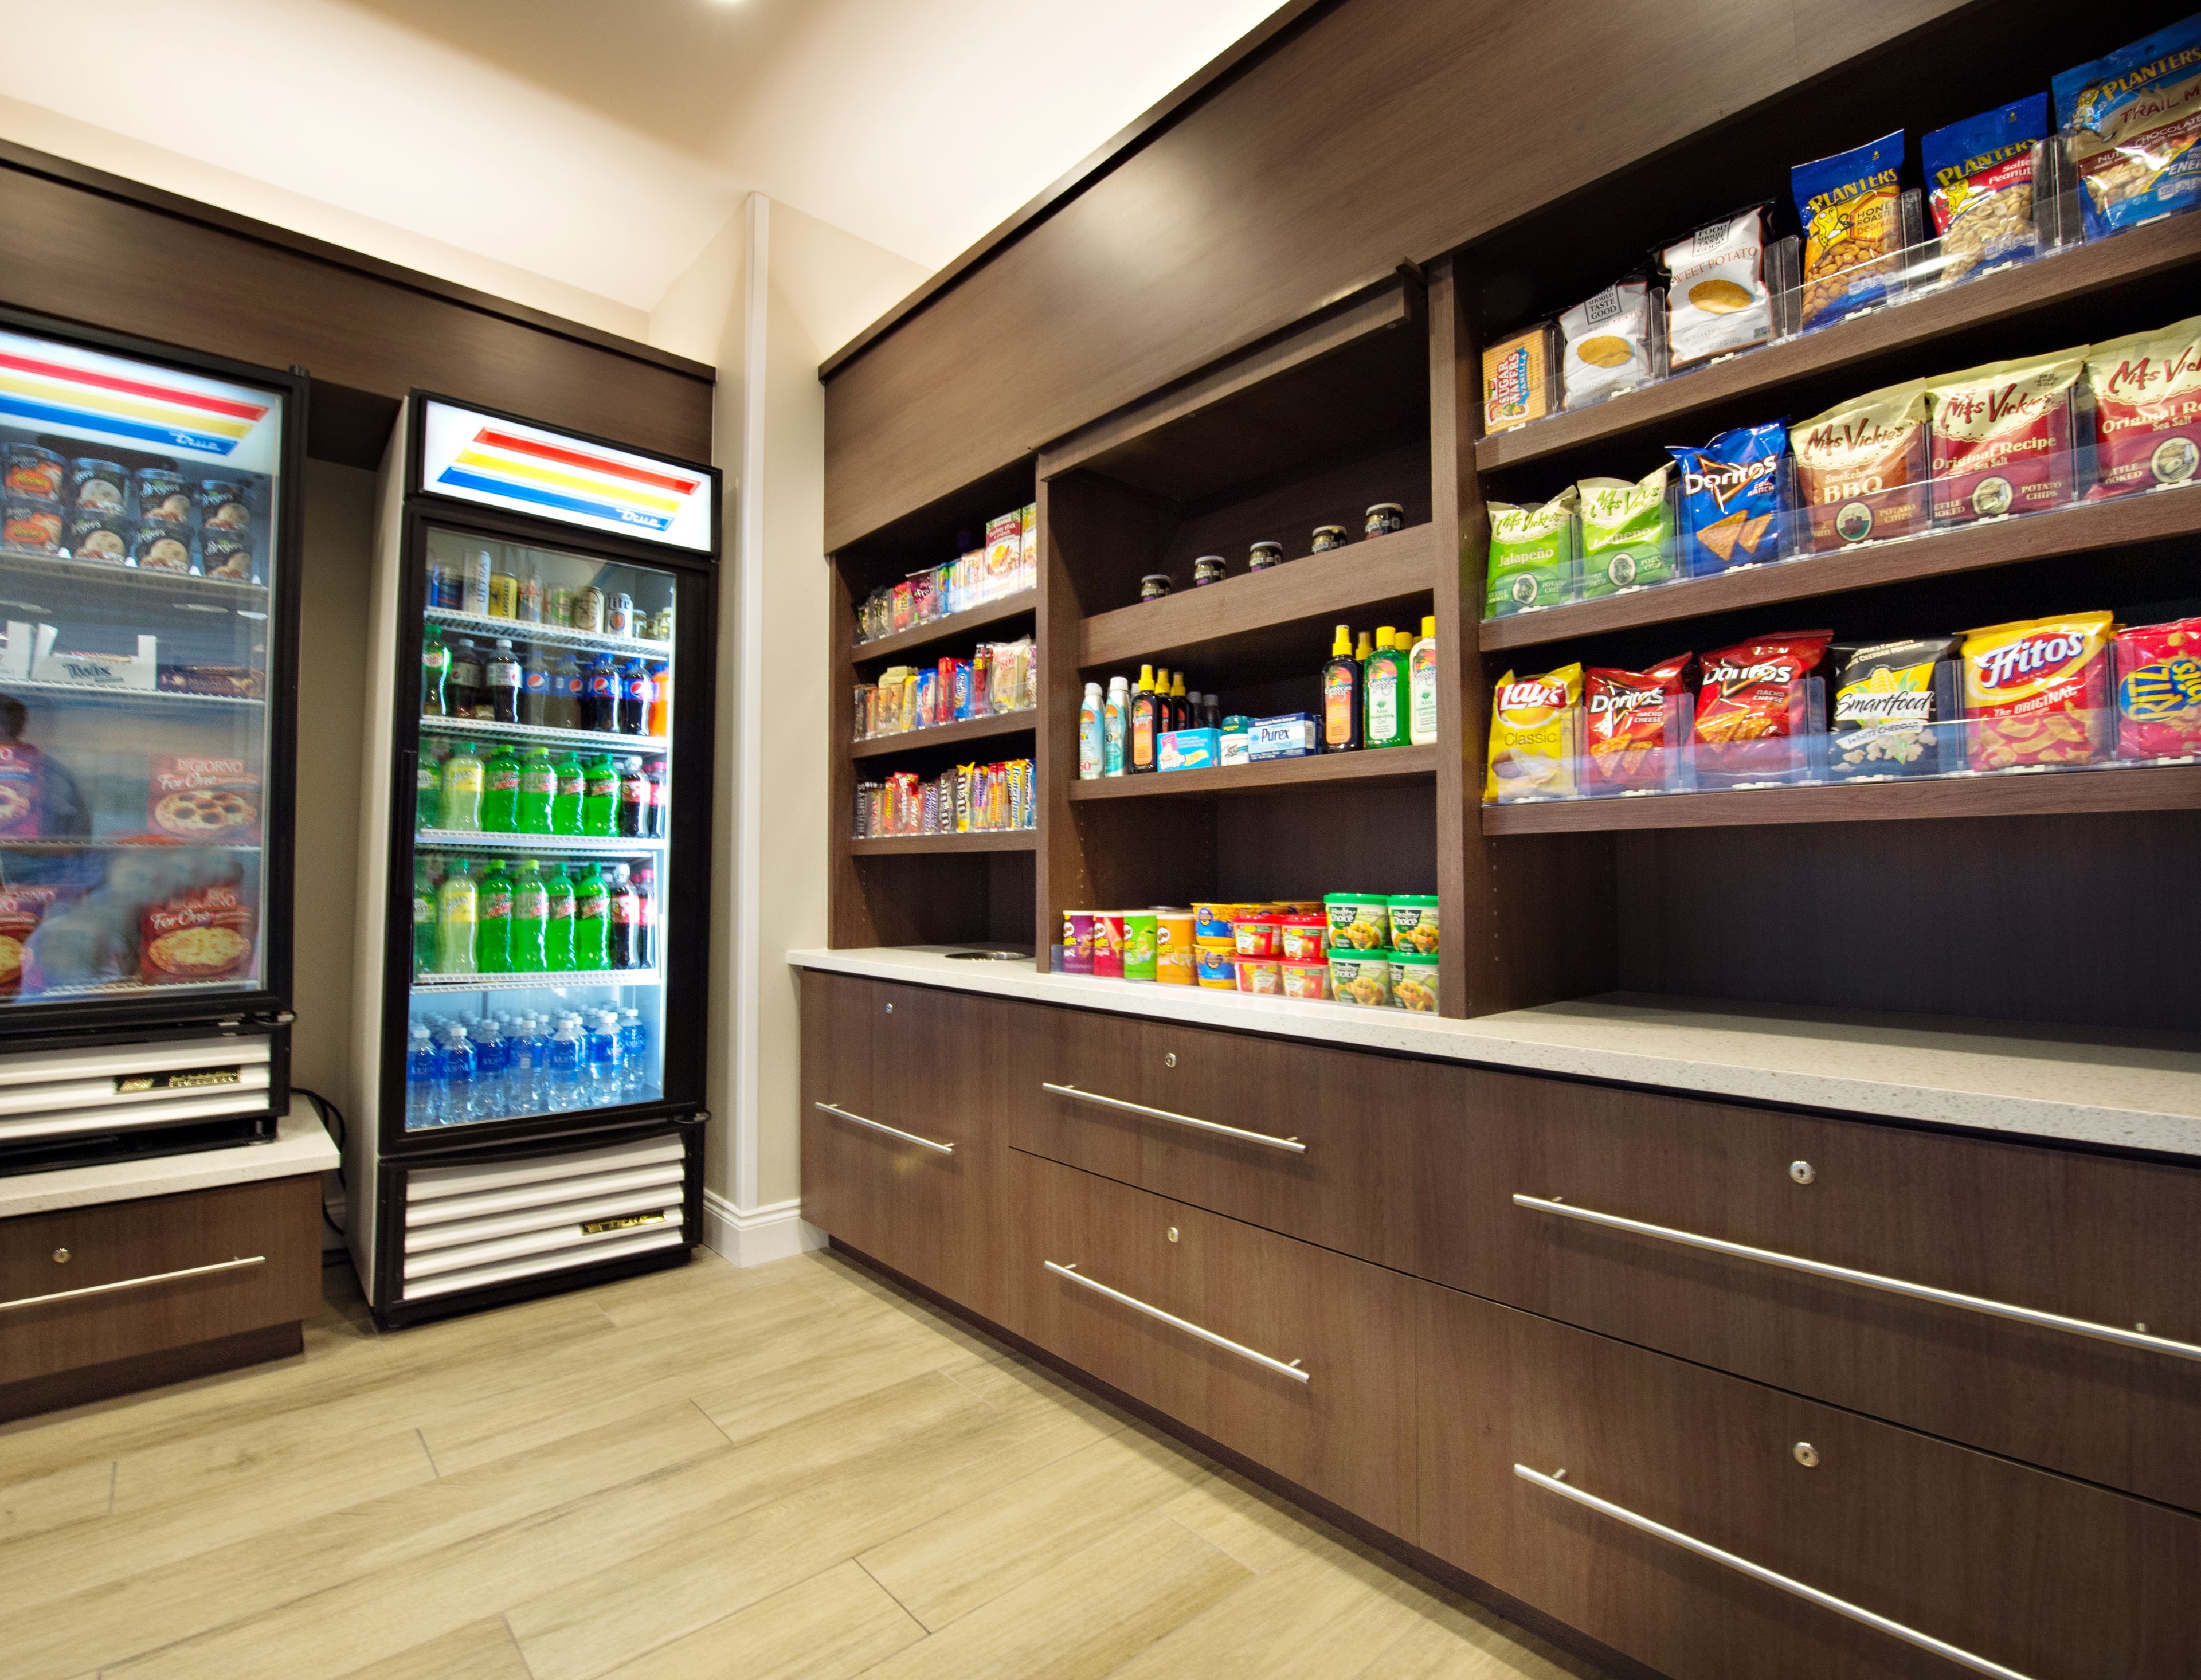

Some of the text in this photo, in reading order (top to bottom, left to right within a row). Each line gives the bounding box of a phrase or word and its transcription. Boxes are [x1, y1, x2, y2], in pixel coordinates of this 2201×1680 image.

[2102, 47, 2201, 101] PLANTERS
[2120, 97, 2180, 124] TRAIL
[2135, 115, 2201, 147] CHOCOLATE
[1936, 138, 2038, 187] PLANTERS
[2002, 159, 2032, 173] Salte
[1808, 169, 1898, 213] PLANTERS
[1698, 224, 1728, 236] FOOD
[1697, 238, 1725, 253] GOOD
[1708, 246, 1758, 270] POTATO
[1588, 292, 1614, 306] SHOULD
[1589, 298, 1615, 312] TASTE
[1591, 305, 1616, 320] GOOD
[1498, 359, 1509, 403] SUGAR
[1508, 352, 1521, 404] WAFERS
[1519, 353, 1528, 396] VANILLA
[2102, 405, 2176, 434] Original
[2152, 415, 2192, 432] Sea Salt
[1843, 417, 1904, 453] Vickie's
[1932, 436, 2057, 471] Original Recipe
[1974, 456, 2008, 471] Sea Salt
[1685, 454, 1779, 495] Doritos
[1824, 465, 1883, 484] Smokehouse
[1747, 485, 1775, 498] RANCH
[1823, 475, 1883, 505] BBQ
[2020, 481, 2063, 494] POTATO
[2026, 489, 2059, 501] CHIPS
[1879, 503, 1916, 517] POTATO
[1933, 498, 1963, 511] ETTLE
[614, 507, 663, 528] True
[1883, 512, 1913, 524] CHIPS
[1588, 526, 1652, 551] Jalapeño
[1498, 547, 1554, 567] Jalapeño
[476, 562, 487, 603] ULTRA
[608, 594, 630, 611] Lite
[1974, 632, 2085, 689] Fritos
[1703, 664, 1793, 686] Doritos
[1500, 682, 1565, 713] Lay's
[1589, 687, 1664, 714] Doritos
[1752, 695, 1784, 704] CHEESE
[1756, 690, 1785, 698] NACHO
[1994, 684, 2078, 717] The ORIGINAL
[2128, 667, 2184, 720] RITZ
[1834, 690, 1936, 719] Smartfood
[1261, 727, 1290, 743] Purex
[1504, 730, 1557, 746] Classic
[1847, 721, 1920, 745] WHITE CHEDDAR
[156, 771, 217, 791] For One
[150, 913, 174, 930] For
[1330, 914, 1354, 922] Choice
[1393, 917, 1419, 926] Choice
